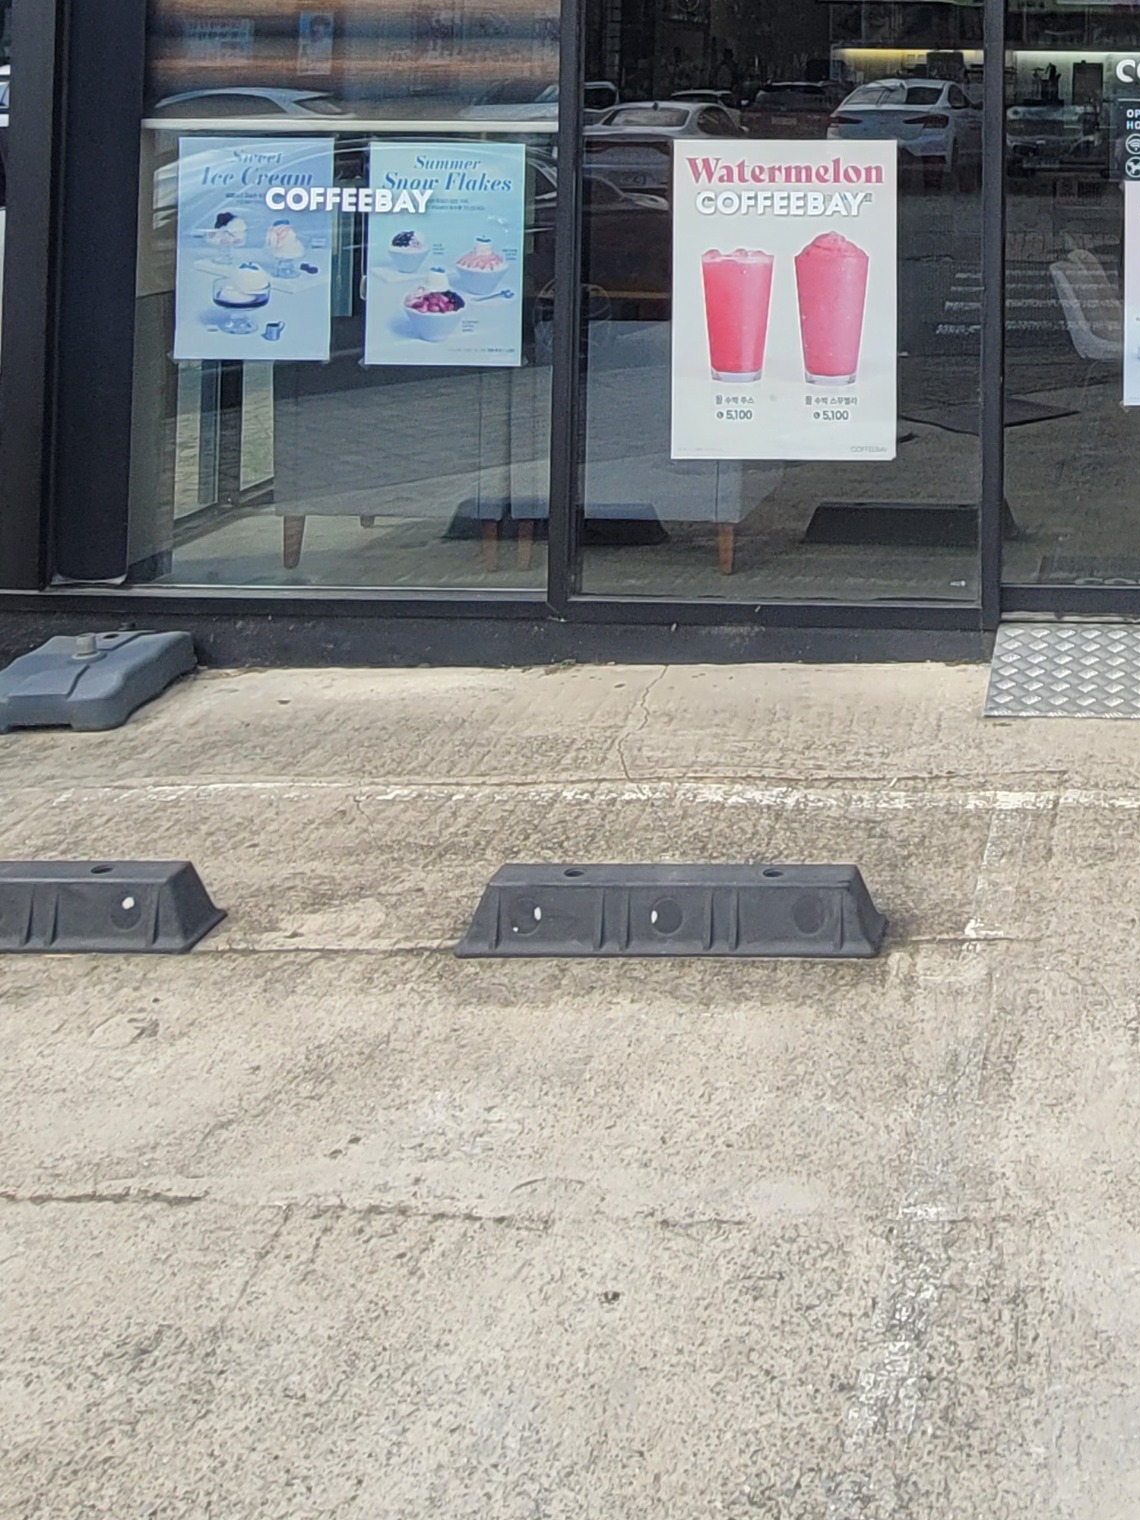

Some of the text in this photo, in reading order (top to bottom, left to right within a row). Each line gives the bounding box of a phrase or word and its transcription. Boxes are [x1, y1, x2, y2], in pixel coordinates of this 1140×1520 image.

[232, 150, 283, 165] Sweet
[414, 154, 482, 170] Summer
[201, 165, 313, 186] Ice Cream
[686, 156, 885, 185] Watermelon
[382, 171, 512, 191] Snow Flakes
[265, 186, 434, 214] COFFEEBAY
[696, 191, 867, 216] COFFEEBAY
[725, 409, 753, 421] 5,100
[821, 410, 850, 421] 5,100
